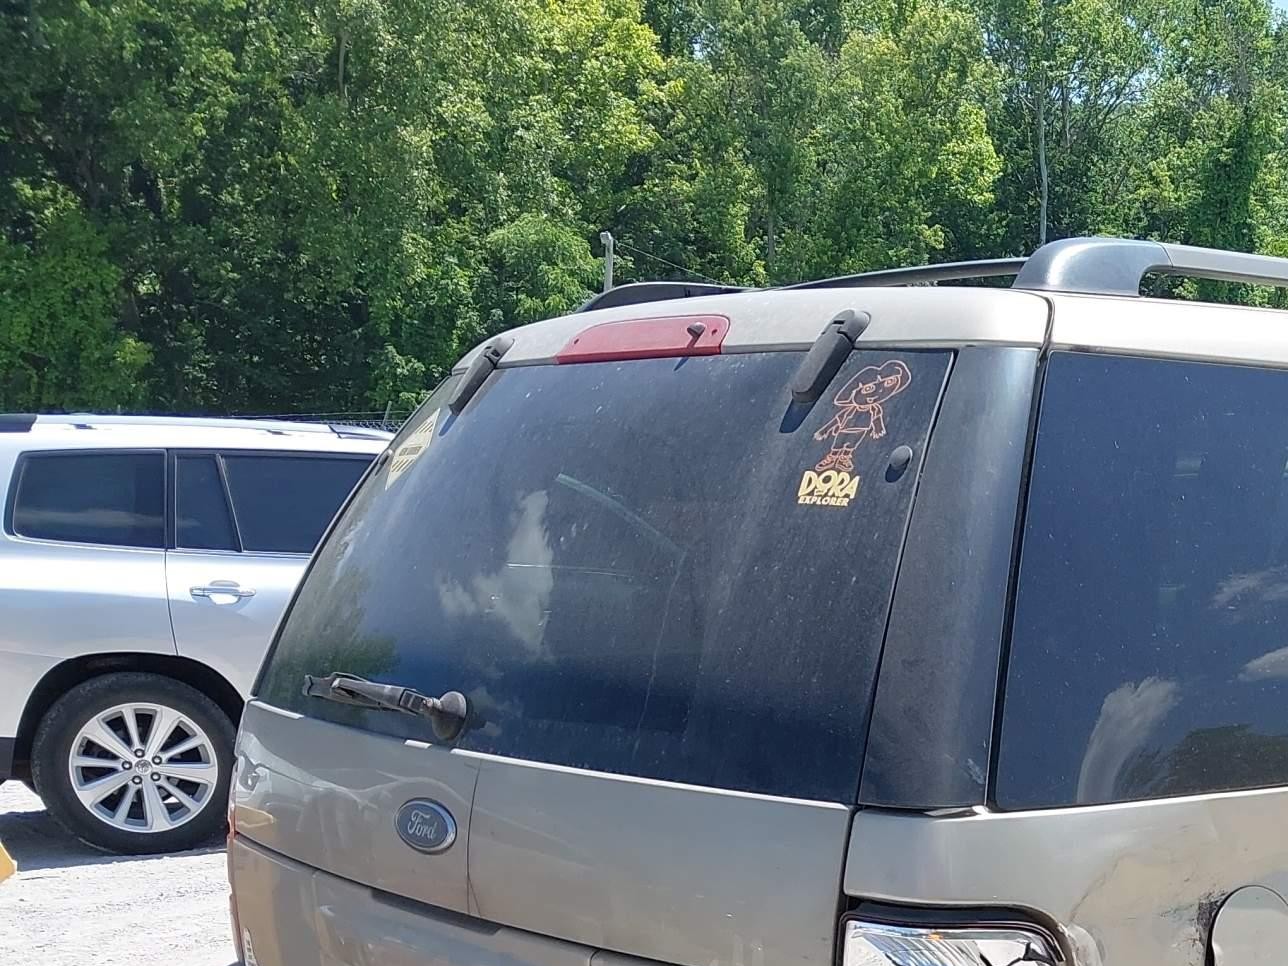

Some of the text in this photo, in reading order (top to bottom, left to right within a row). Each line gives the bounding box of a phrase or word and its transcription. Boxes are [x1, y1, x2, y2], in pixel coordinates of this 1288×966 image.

[798, 470, 860, 499] DORA
[798, 495, 850, 507] EXPLORER
[407, 809, 438, 839] Ford
